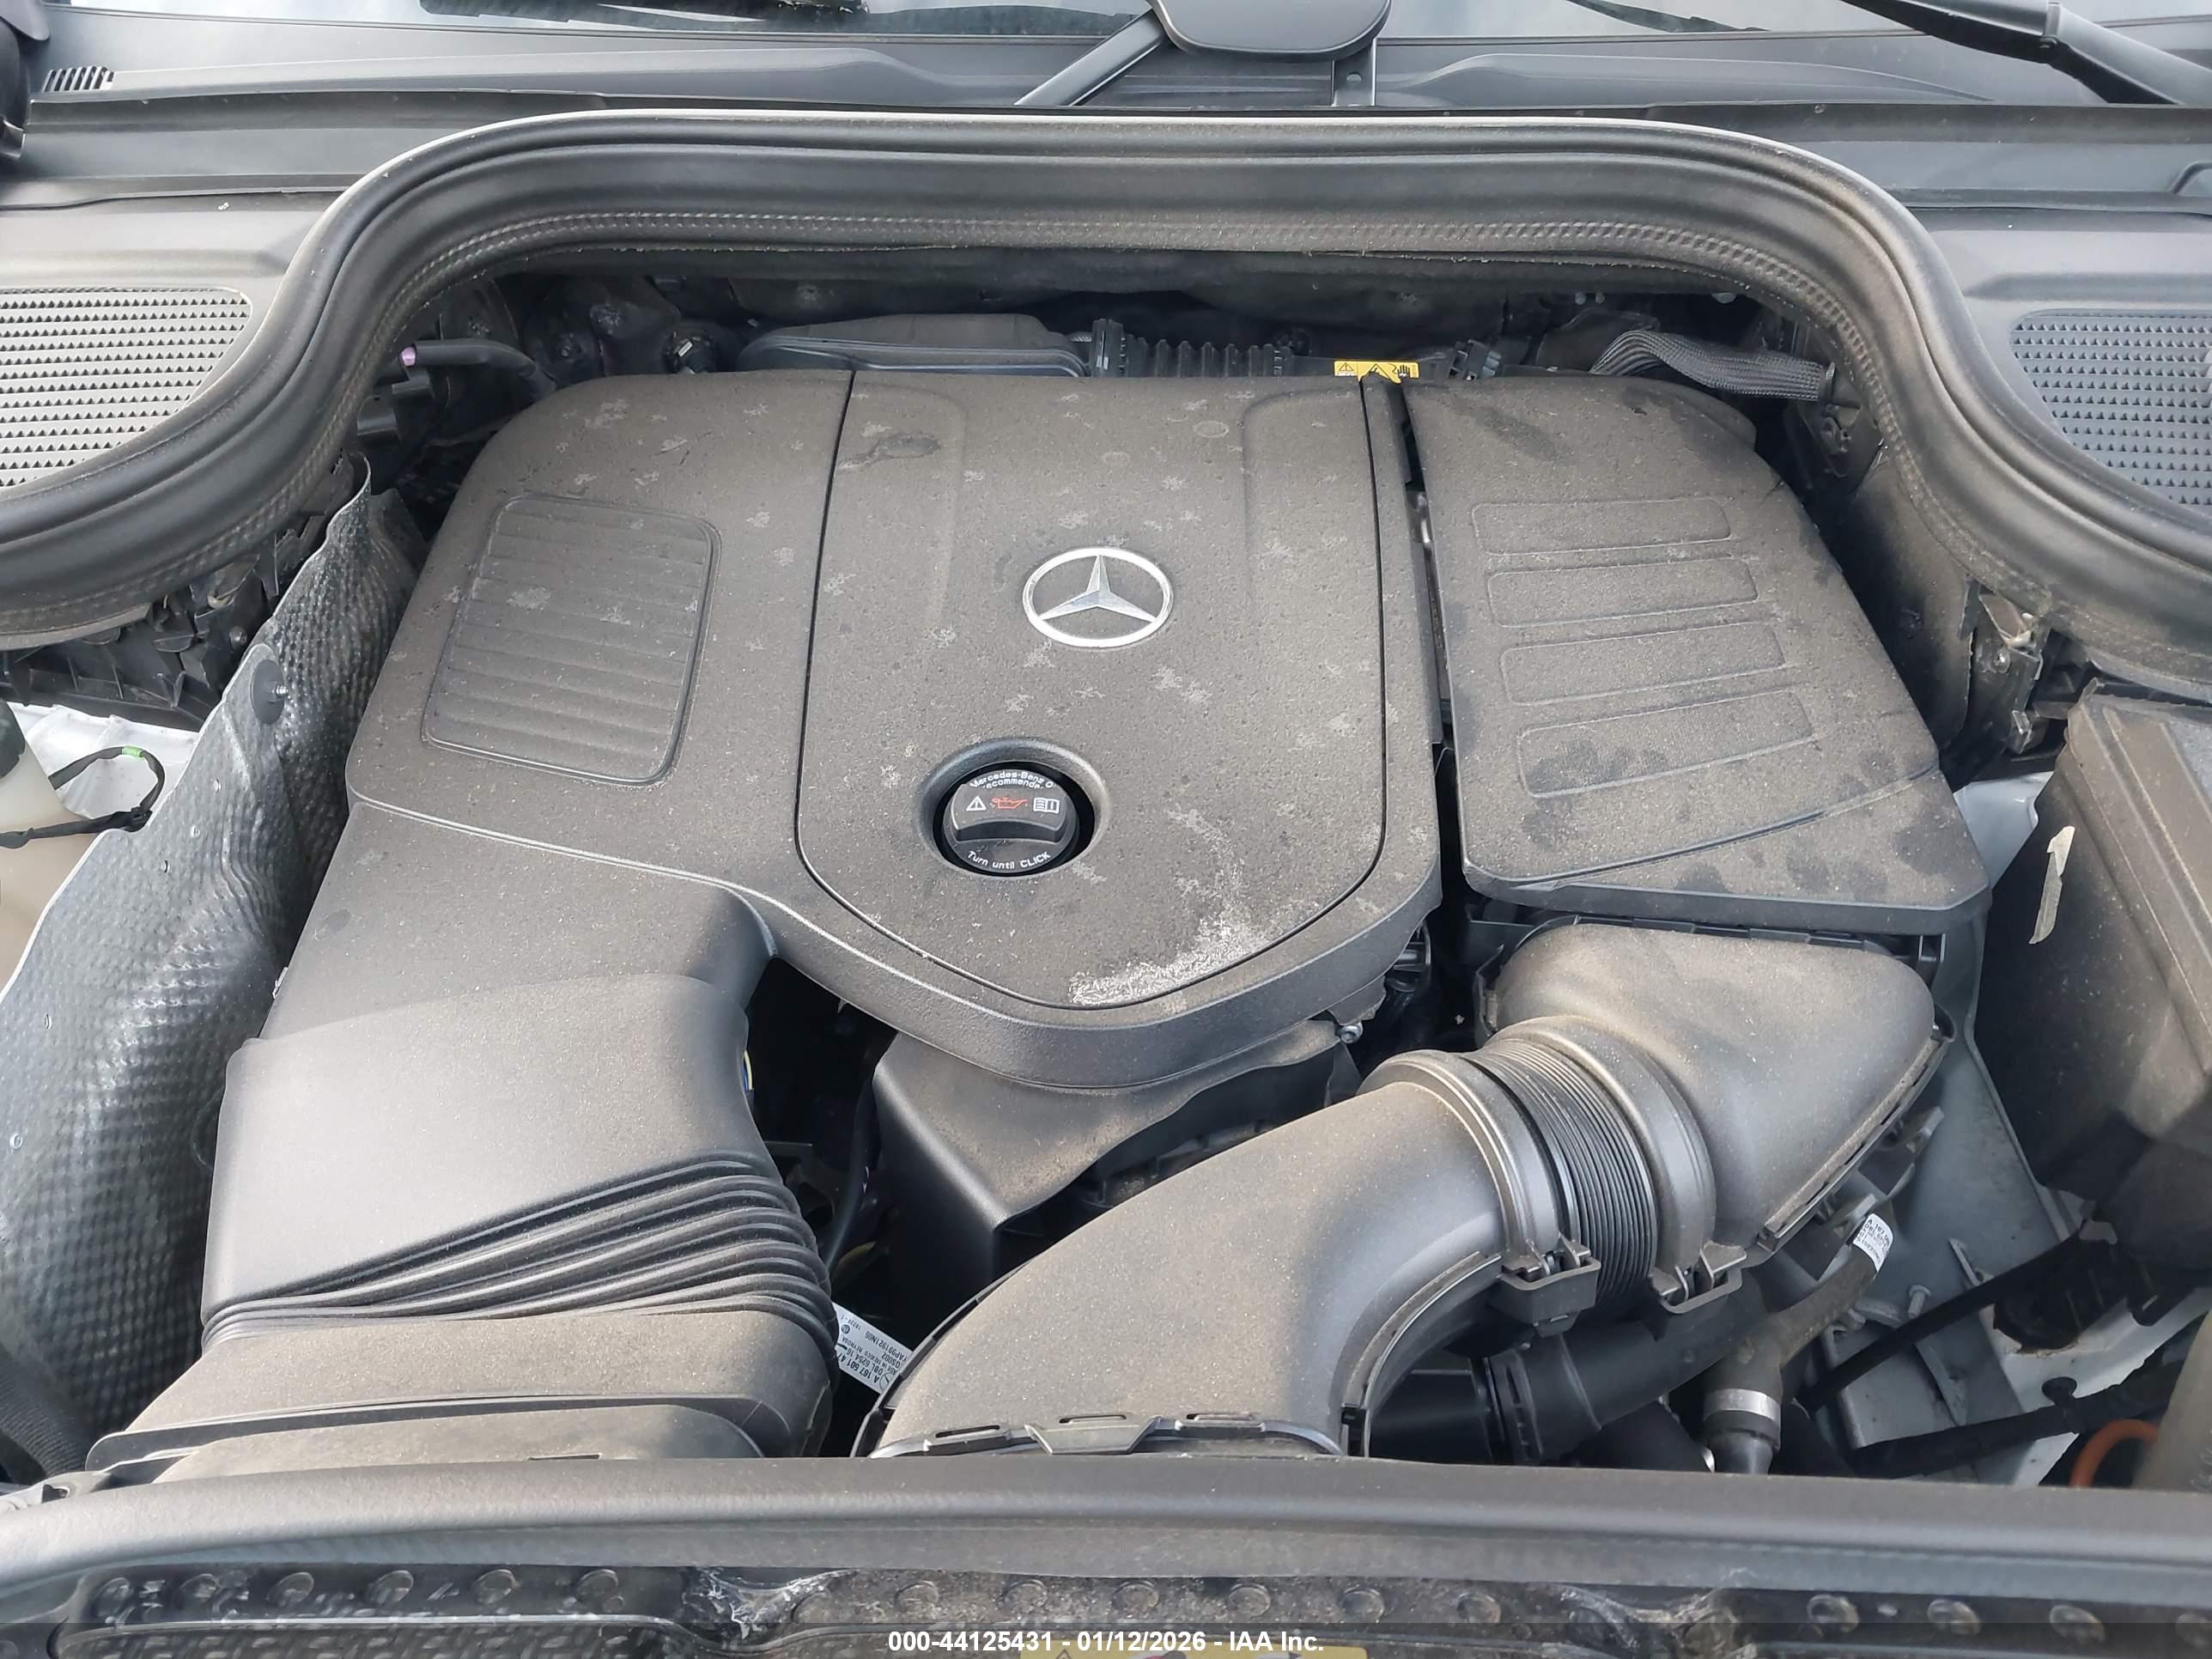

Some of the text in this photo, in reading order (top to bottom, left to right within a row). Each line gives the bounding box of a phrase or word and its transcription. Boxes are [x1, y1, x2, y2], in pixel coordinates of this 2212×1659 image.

[982, 778, 1043, 789] ecommende
[968, 850, 1051, 870] Turn until CLICK
[859, 1367, 872, 1379] 167
